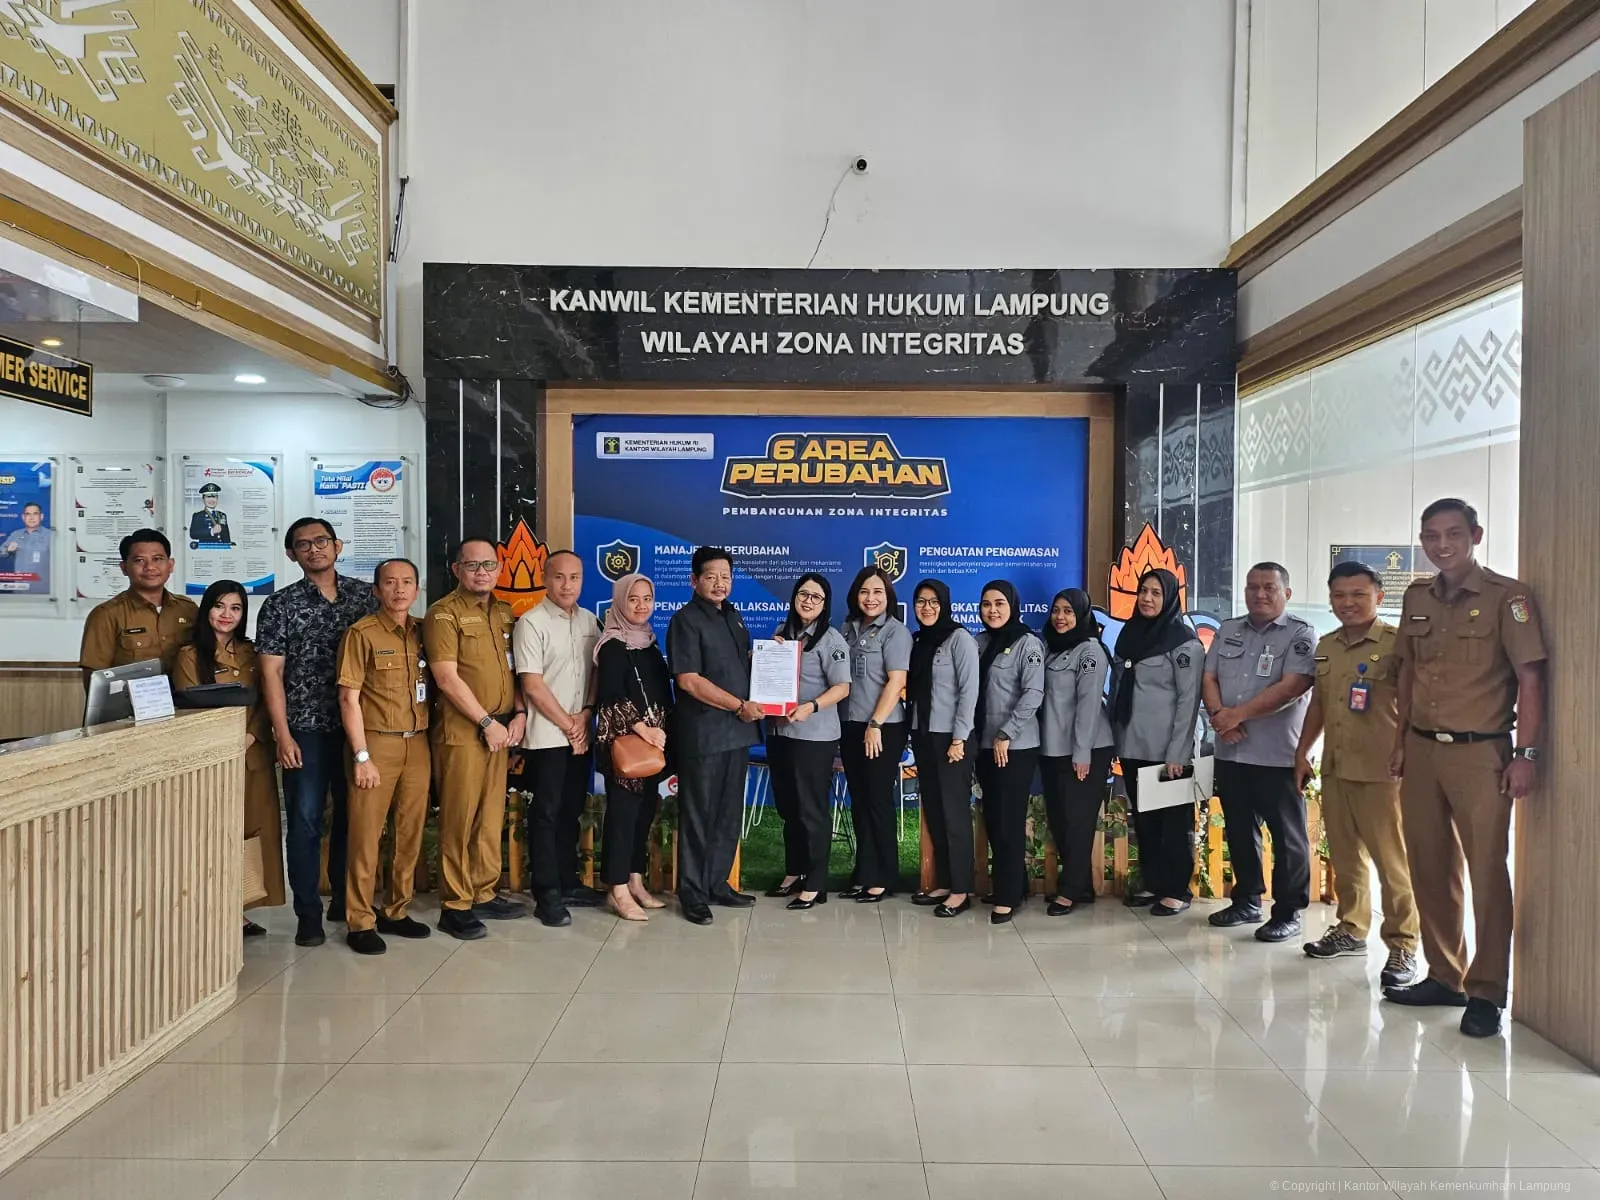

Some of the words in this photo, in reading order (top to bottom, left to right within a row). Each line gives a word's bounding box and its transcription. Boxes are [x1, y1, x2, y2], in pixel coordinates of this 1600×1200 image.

[550, 290, 656, 313] KANWIL
[664, 291, 857, 316] KEMENTERIAN
[868, 293, 964, 316] HUKUM
[974, 293, 1108, 316] LAMPUNG
[640, 332, 768, 354] WILAYAH
[776, 332, 853, 354] ZONA
[862, 332, 1024, 355] INTEGRITAS
[30, 360, 87, 400] SERVICE
[773, 440, 790, 460] 6
[800, 440, 894, 461] AREA
[729, 463, 942, 486] PERUBAHAN
[722, 507, 823, 516] PEMBANGUNAN
[829, 508, 864, 516] ZONA
[870, 508, 948, 516] INTEGRITAS
[724, 546, 790, 555] PERUBAHAN
[920, 547, 983, 556] PENGUATAN
[986, 548, 1059, 557] PENGAWASAN
[1020, 604, 1048, 613] LITAS
